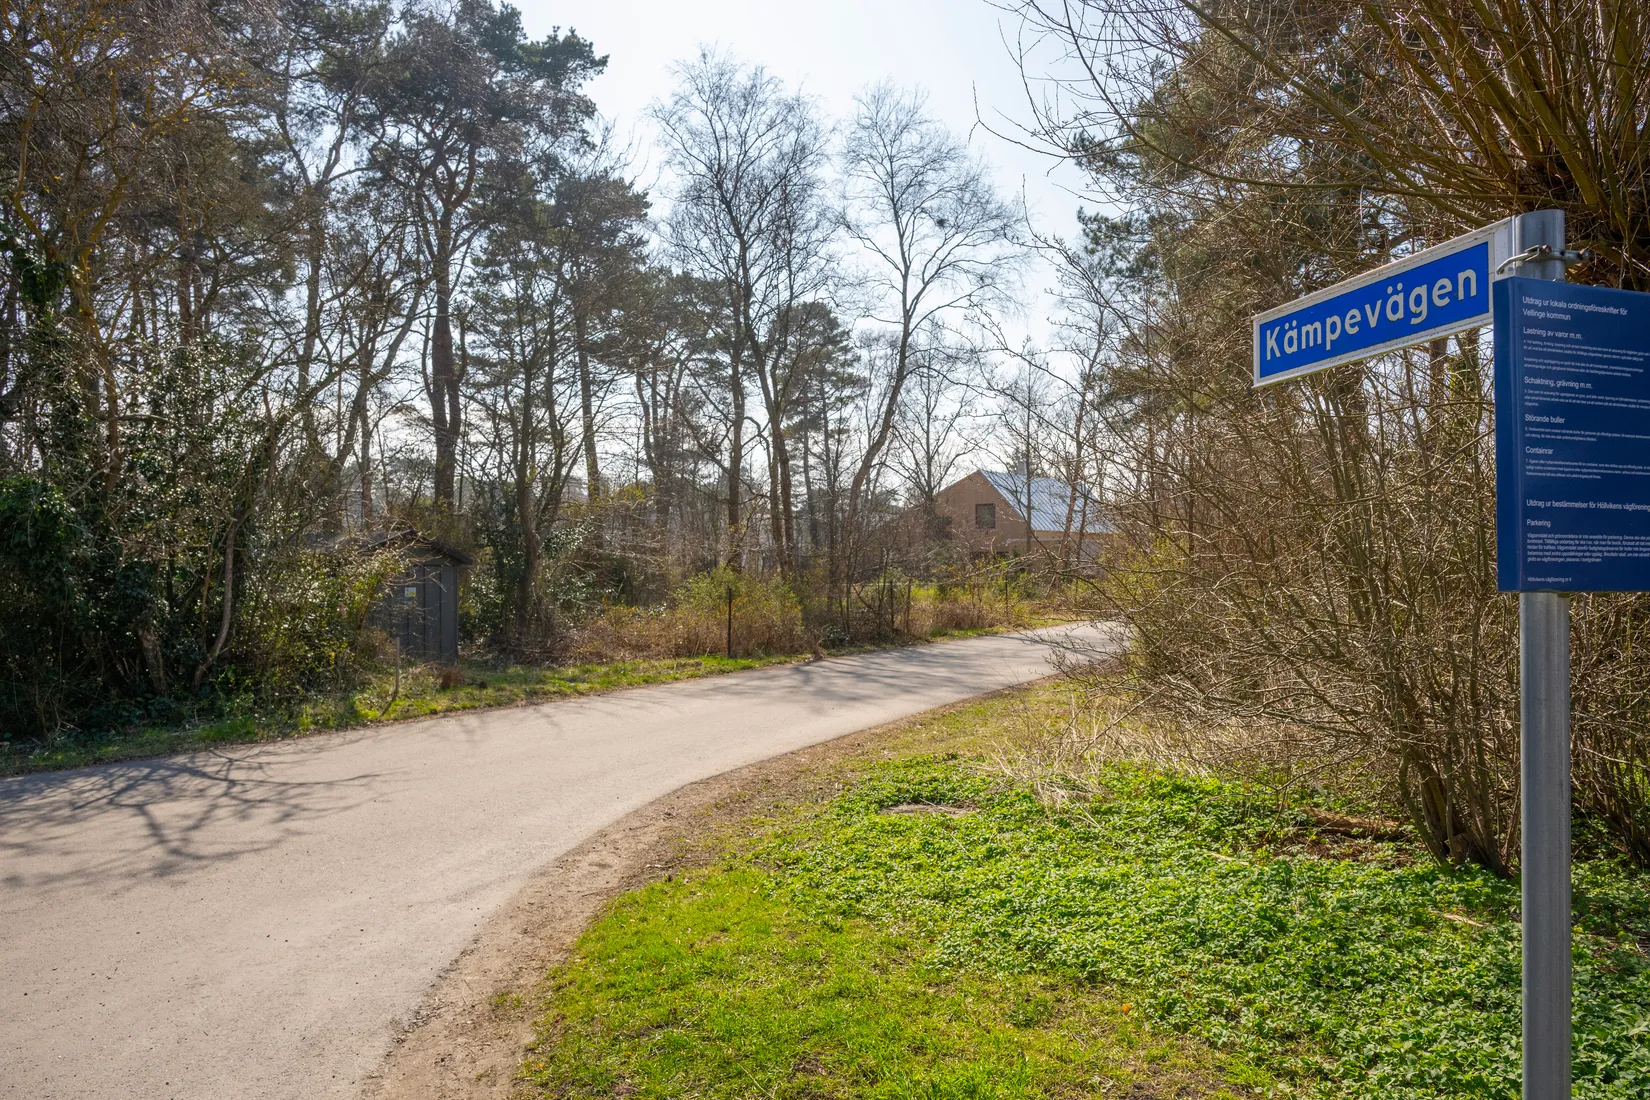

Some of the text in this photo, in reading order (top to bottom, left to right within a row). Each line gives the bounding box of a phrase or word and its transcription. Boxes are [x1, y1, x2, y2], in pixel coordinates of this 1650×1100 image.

[1522, 296, 1541, 307] Utdrag
[1550, 300, 1567, 308] lokala
[1568, 302, 1619, 314] ordningsföreskrifter
[1266, 268, 1477, 361] Kämpevägen
[1522, 308, 1571, 320] Vellinge kommun
[1523, 326, 1546, 337] Lastning
[1524, 376, 1555, 387] Schaktning,
[1556, 380, 1579, 389] grävning
[1525, 413, 1549, 422] Störande
[1525, 446, 1553, 454] Containrar
[1526, 499, 1544, 508] Utdrag
[1552, 500, 1588, 508] bestämmelser
[1527, 518, 1551, 528] Parkering
